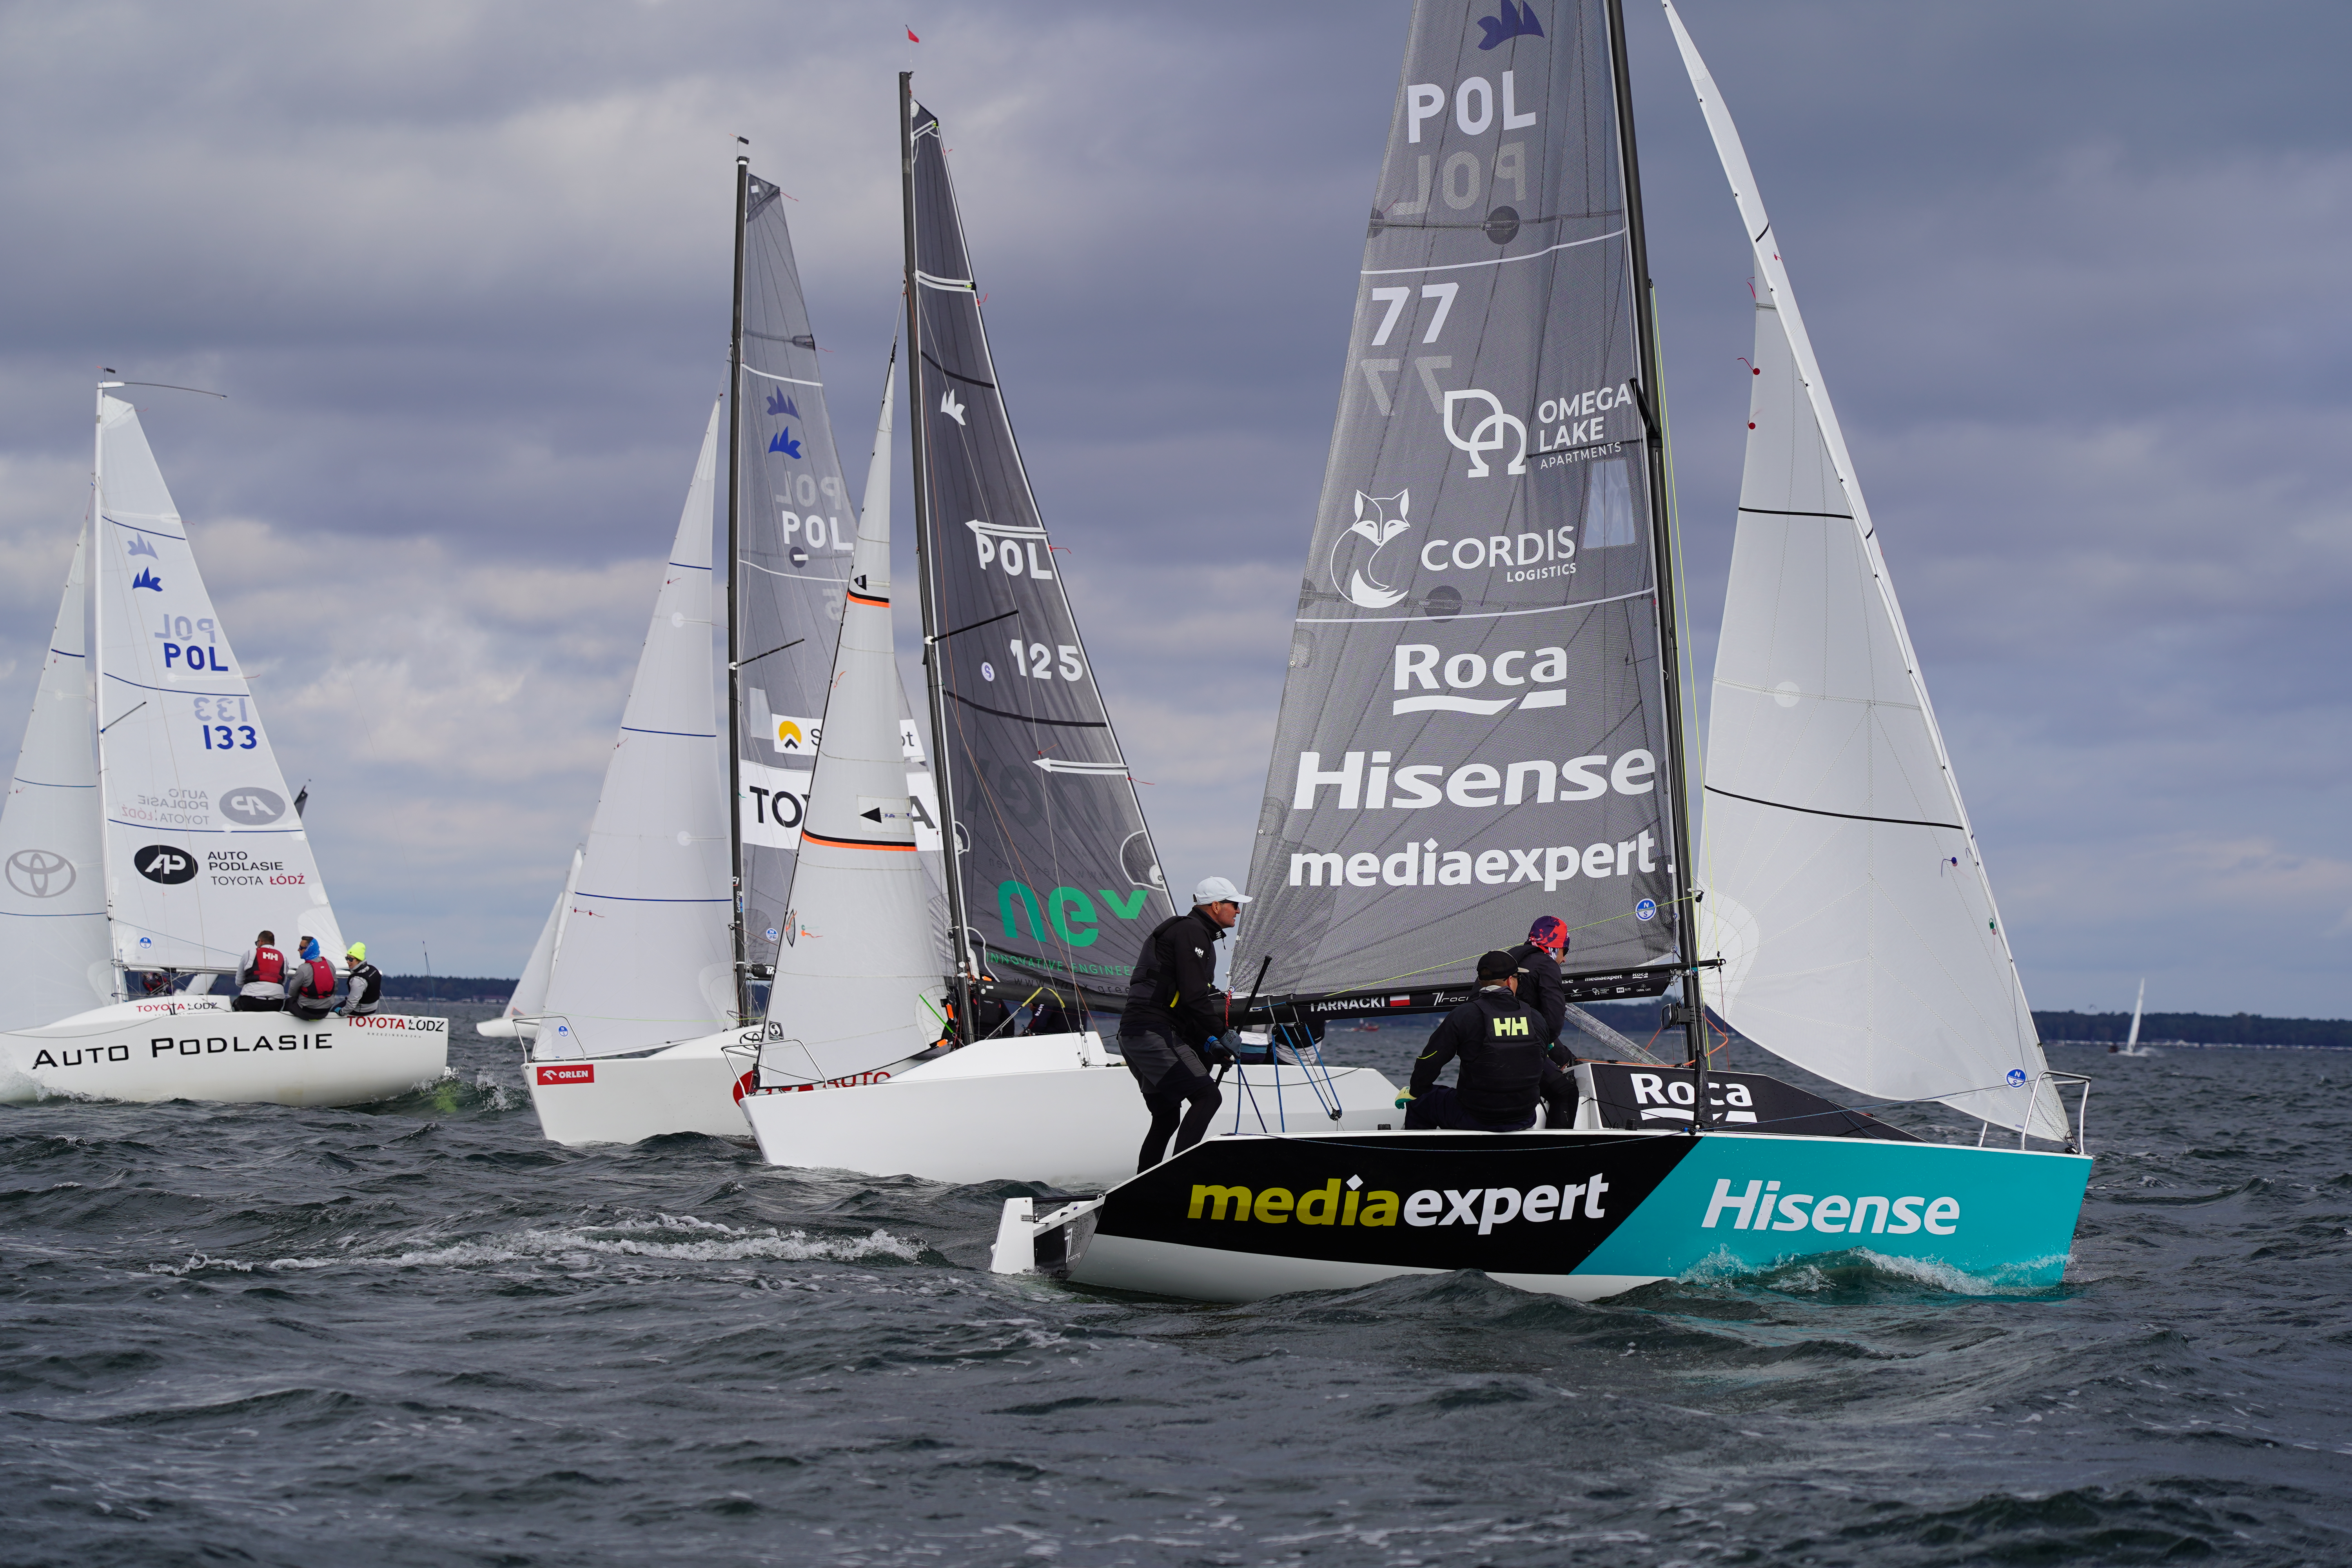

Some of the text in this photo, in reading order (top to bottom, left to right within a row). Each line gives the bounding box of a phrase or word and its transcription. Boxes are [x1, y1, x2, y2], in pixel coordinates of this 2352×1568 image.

[1408, 71, 1536, 143] POL
[1371, 282, 1459, 346] 77
[1538, 383, 1632, 423] OMEGA
[1539, 416, 1604, 452] LAKE
[1540, 441, 1622, 469] APARTMENTS
[782, 510, 854, 550] POL
[976, 532, 1053, 580] POL
[1421, 526, 1575, 572] CORDIS
[1506, 562, 1577, 583] LOGISTICS
[163, 643, 228, 671] POL
[1010, 639, 1083, 682] 125
[1394, 644, 1567, 690] Roca
[203, 725, 257, 750] 133
[1293, 749, 1656, 809] Hisense
[207, 851, 248, 860] AUTO
[209, 862, 284, 871] PODLASIE
[1289, 829, 1655, 891] mediaexpert
[211, 873, 305, 886] TOYOTA ŁÓDŹ
[262, 952, 278, 961] HH
[987, 951, 1136, 976] INNOVATIVE ENGINEE
[136, 1004, 185, 1013] TOYOTA
[347, 1016, 405, 1029] TOYOTA
[1493, 1017, 1529, 1036] HH
[32, 1033, 333, 1069] AUTO PODLASIE
[559, 1070, 588, 1079] ORLEN
[1188, 1173, 1610, 1235] mediaexpert
[1702, 1179, 1960, 1235] Hisense
